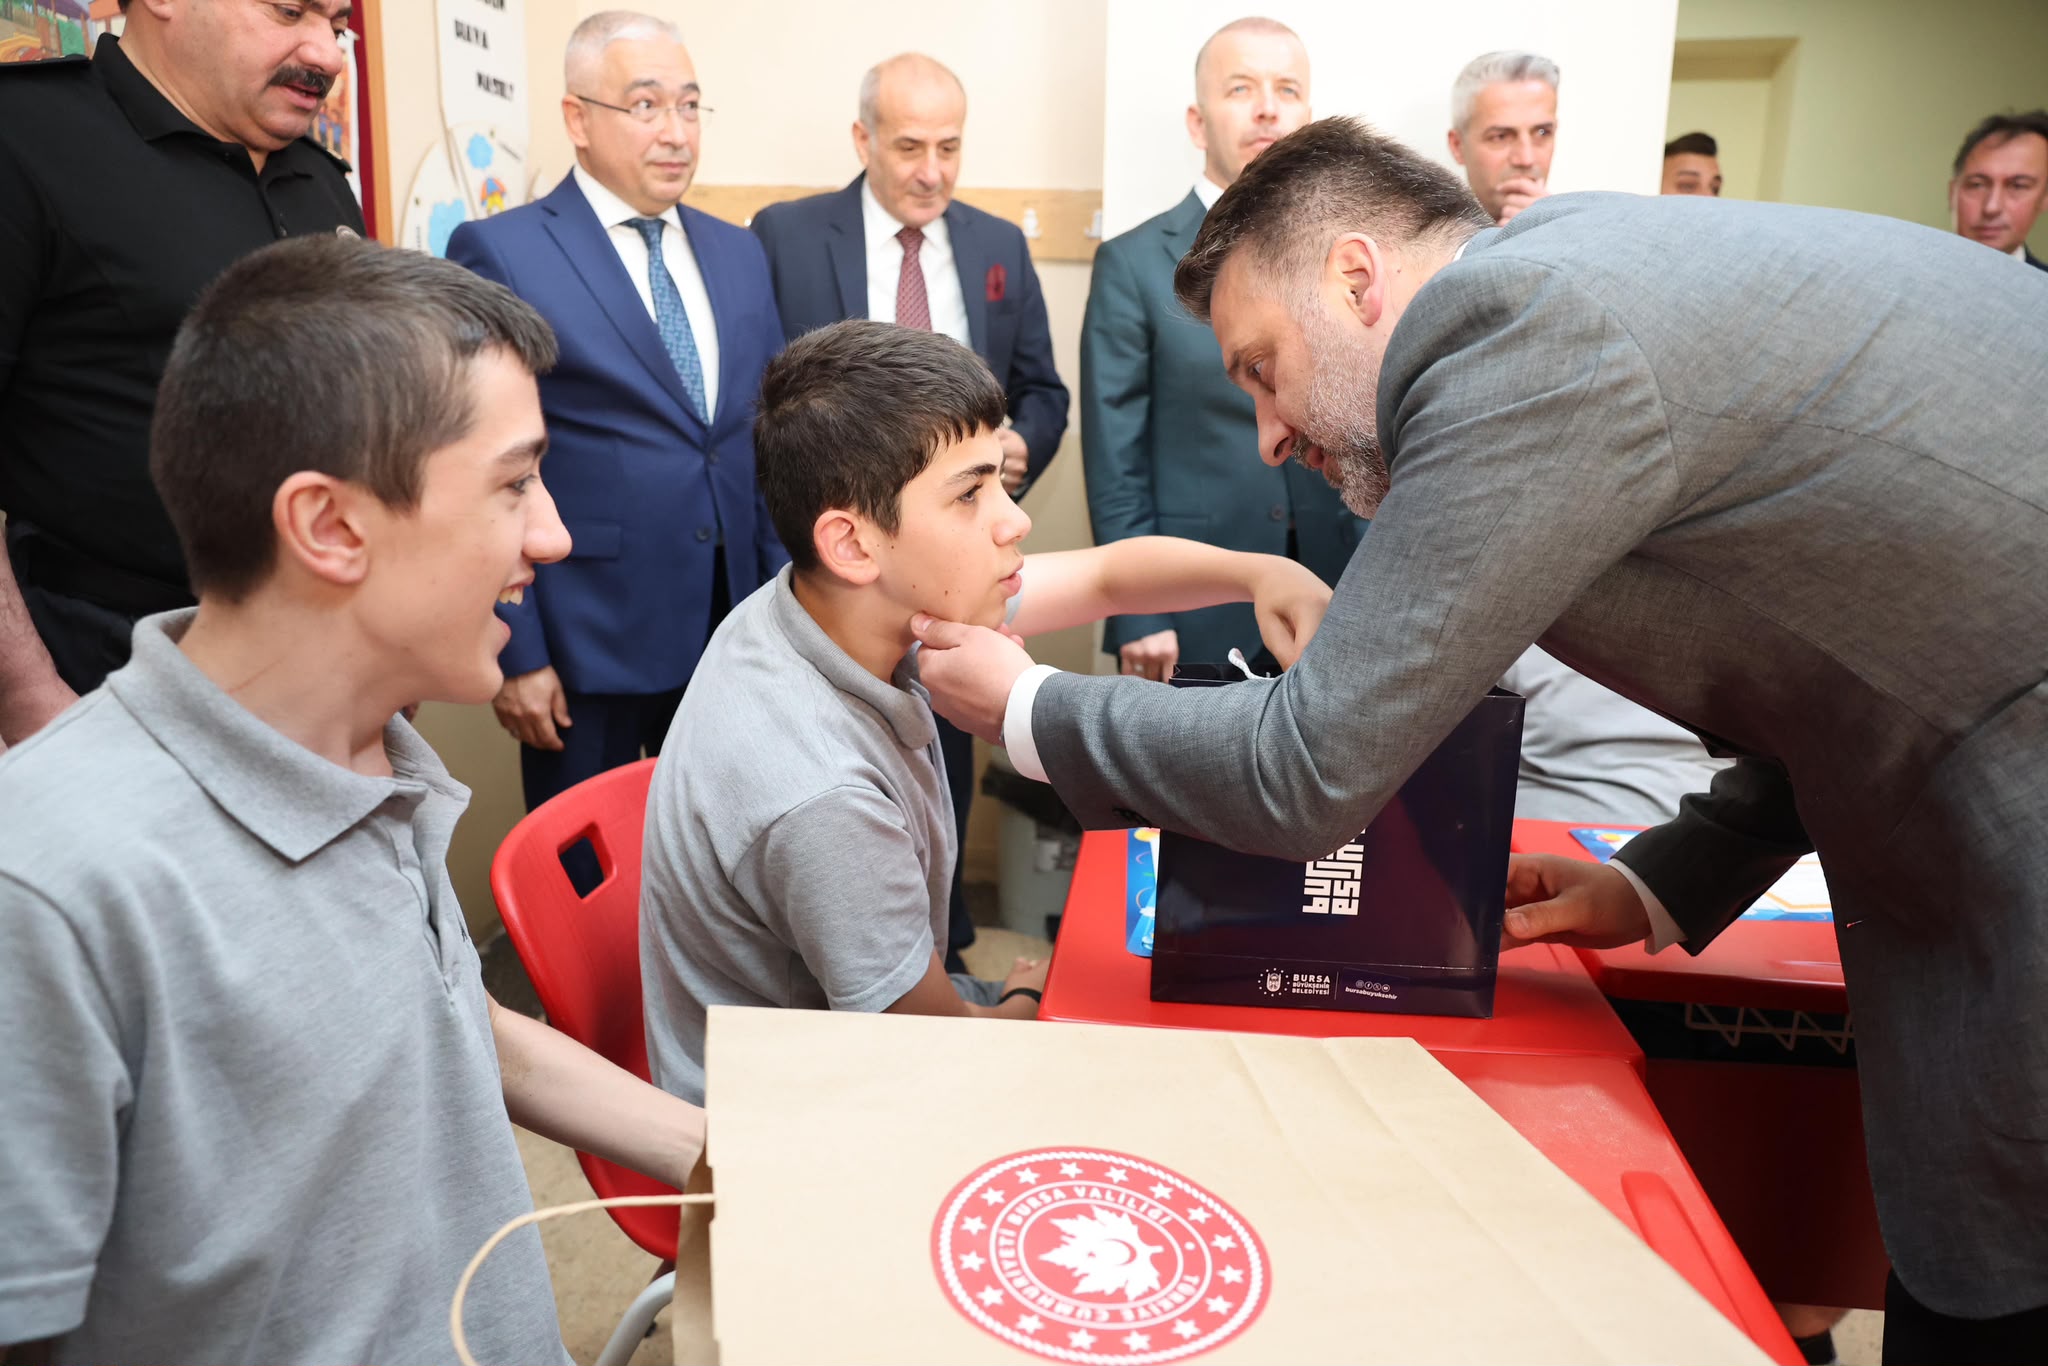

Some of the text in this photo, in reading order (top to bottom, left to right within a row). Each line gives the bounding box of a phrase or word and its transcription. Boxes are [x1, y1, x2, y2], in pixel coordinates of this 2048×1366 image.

[1293, 974, 1331, 983] BURSA
[1292, 981, 1330, 989] BÜYÜKŞEHİR
[1345, 987, 1398, 1000] bursabuyuksehir
[998, 1186, 1201, 1322] TÜRKİYE CUMHURİYETİ BURSA VALİLİĞİ
